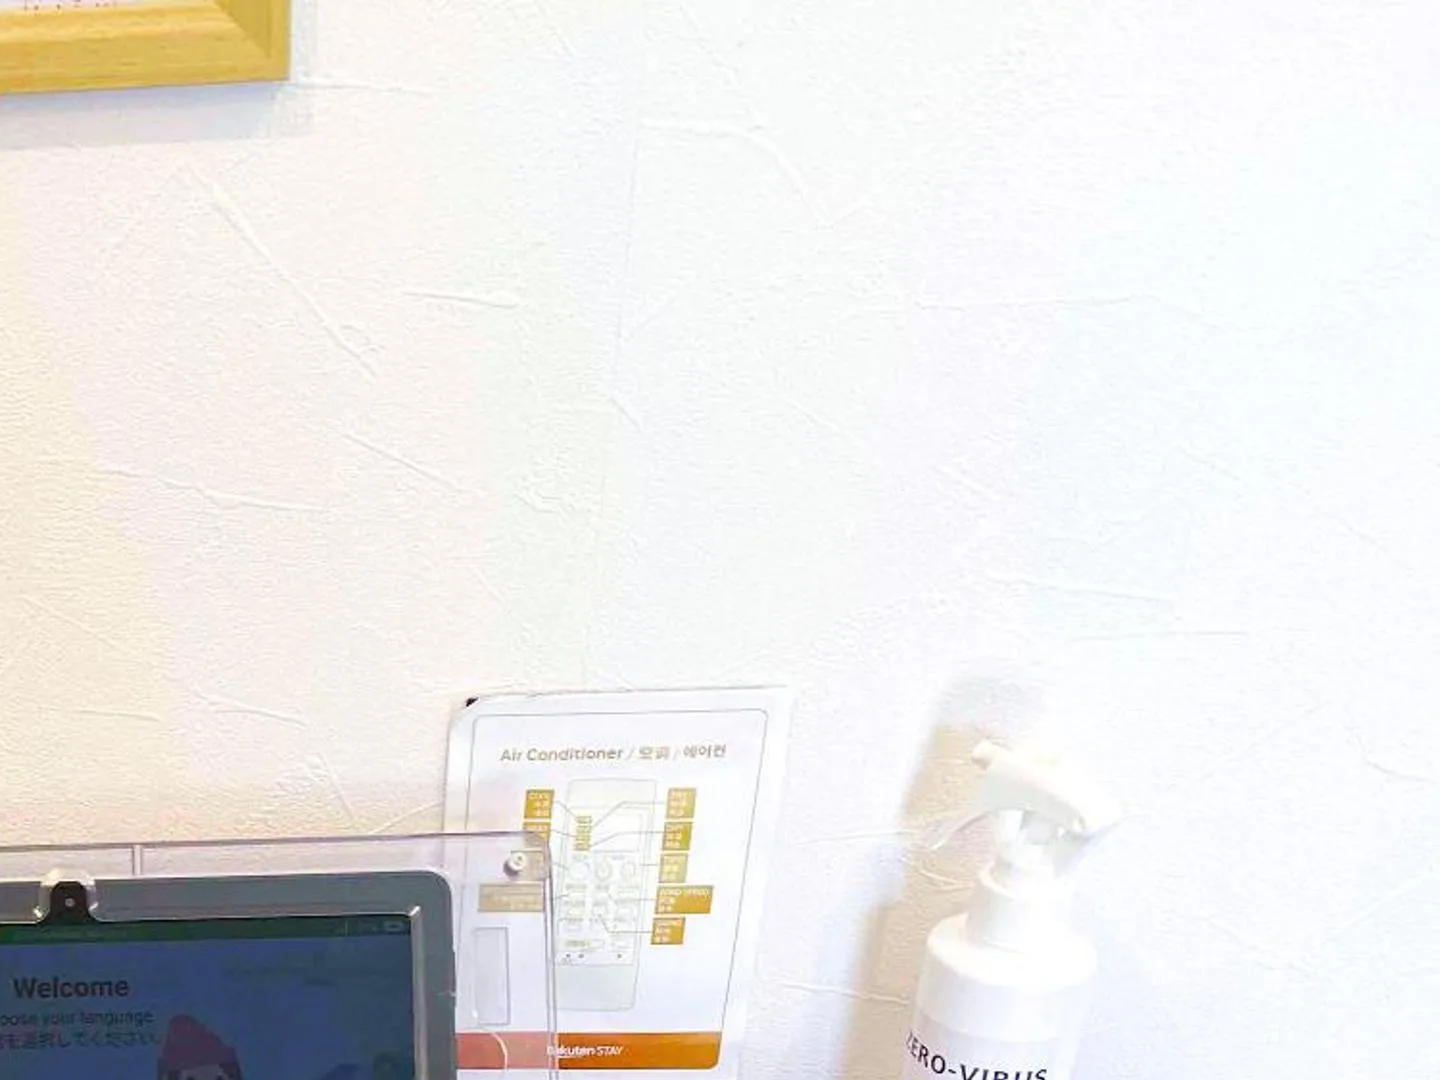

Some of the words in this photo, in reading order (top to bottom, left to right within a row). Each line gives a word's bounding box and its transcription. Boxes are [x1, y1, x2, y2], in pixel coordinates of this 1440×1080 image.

[499, 746, 522, 763] Air
[526, 745, 624, 762] Conditioner
[12, 976, 130, 998] Welcome
[42, 1012, 75, 1029] your
[80, 1010, 155, 1028] language
